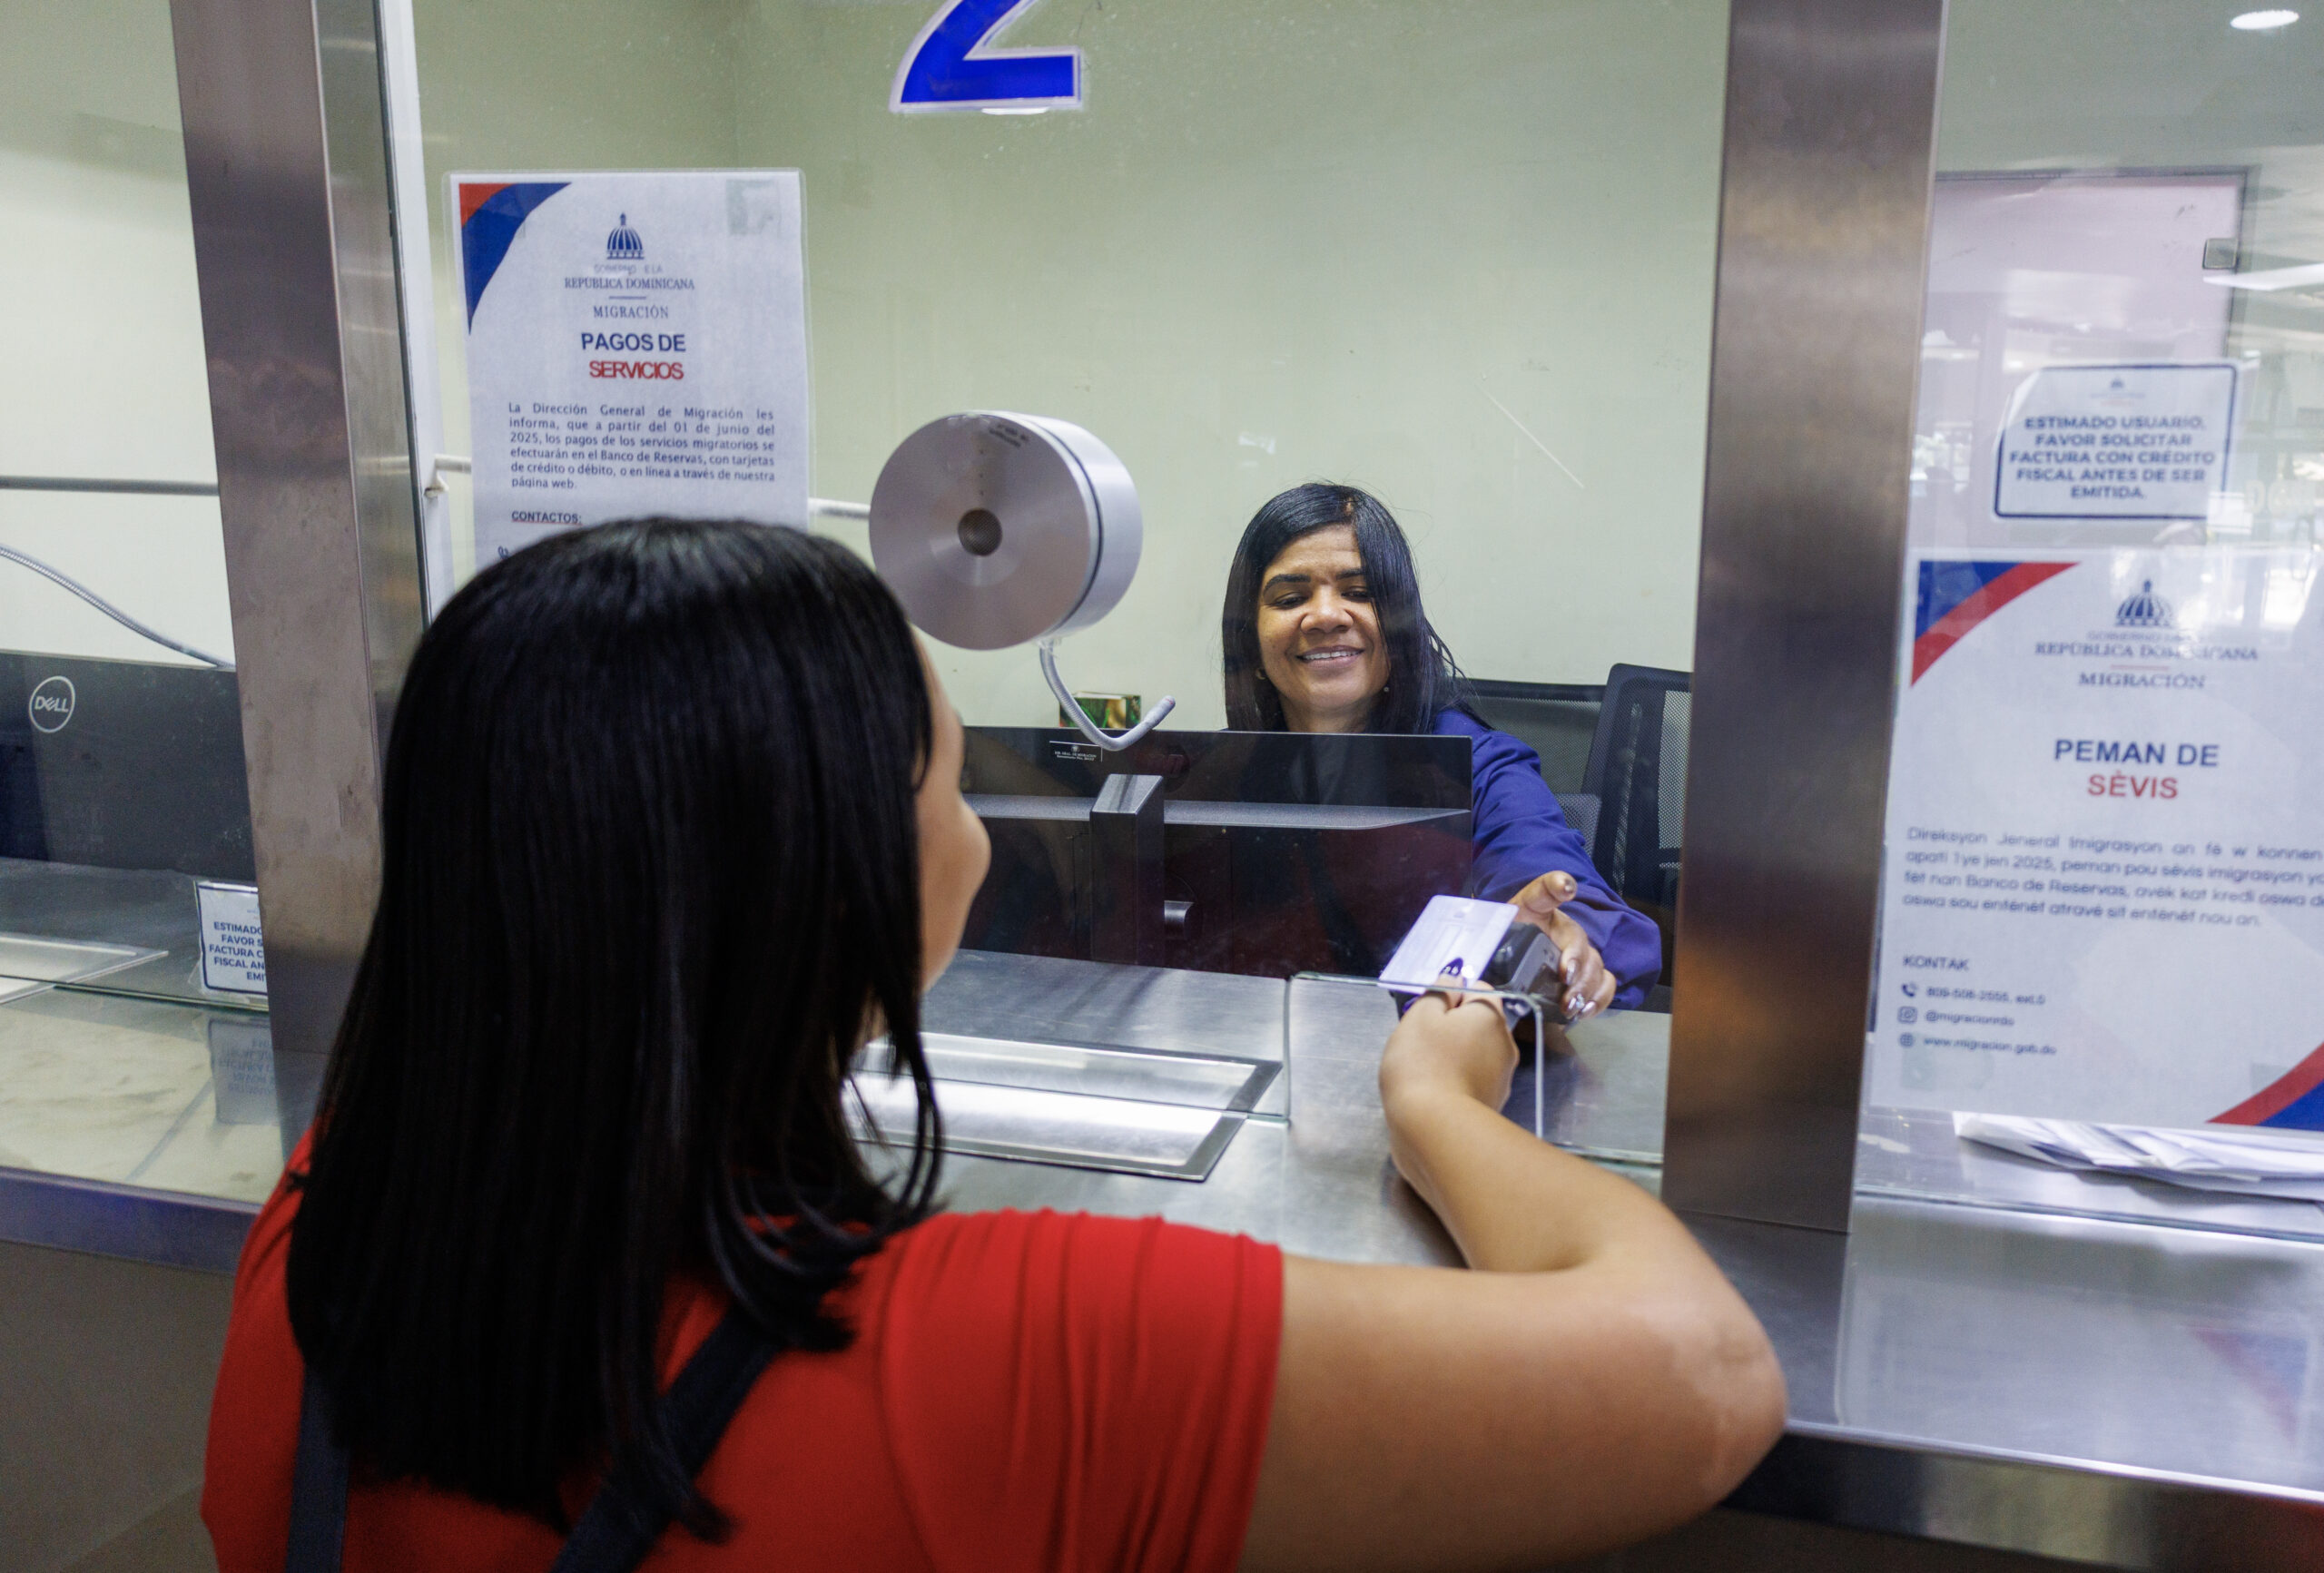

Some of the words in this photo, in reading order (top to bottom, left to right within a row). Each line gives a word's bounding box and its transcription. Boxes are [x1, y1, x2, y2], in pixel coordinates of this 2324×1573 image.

[565, 275, 623, 290] REPÚBLICA
[626, 278, 694, 290] DOMINICANA
[593, 304, 669, 319] MIGRACIÓN
[581, 332, 654, 352] PAGOS
[658, 333, 686, 352] DE
[589, 360, 684, 379] SERVICIOS
[508, 402, 521, 413] La
[533, 402, 587, 415] Dirección
[600, 404, 645, 417] General
[658, 406, 672, 418] de
[684, 407, 743, 420] Migración
[756, 408, 773, 419] les
[509, 418, 559, 430] informa,
[567, 420, 588, 431] que
[596, 422, 602, 430] a
[608, 420, 641, 433] partir
[648, 420, 666, 432] del
[674, 421, 687, 432] 01
[695, 422, 710, 434] de
[717, 423, 750, 436] junio
[757, 424, 774, 436] del
[2024, 416, 2117, 429] ESTIMADO
[510, 431, 542, 445] 2025,
[546, 433, 561, 444] los
[565, 435, 597, 447] pagos
[602, 435, 615, 446] de
[619, 436, 635, 447] los
[640, 437, 688, 448] servicios
[693, 439, 758, 451] migratorios
[763, 442, 774, 451] se
[2034, 434, 2095, 447] FAVOR
[2102, 433, 2193, 447] SOLICITAR
[510, 446, 568, 459] efectuarán
[572, 449, 585, 459] en
[588, 449, 597, 459] el
[601, 450, 634, 461] Banco
[637, 451, 650, 462] de
[654, 451, 707, 465] Reservas,
[709, 456, 730, 465] con
[732, 455, 774, 467] tarjetas
[2009, 451, 2091, 464] FACTURA
[2095, 451, 2133, 464] CON
[2137, 448, 2216, 465] CRÉDITO
[511, 461, 524, 472] de
[527, 462, 566, 474] crédito
[567, 466, 575, 474] o
[577, 464, 616, 477] débito,
[620, 467, 626, 477] o
[629, 467, 643, 477] en
[645, 466, 671, 477] línea
[674, 469, 680, 478] a
[683, 467, 714, 479] través
[718, 468, 731, 480] de
[734, 471, 774, 481] nuestra
[2016, 468, 2074, 481] FISCAL
[2080, 468, 2137, 481] ANTES
[2142, 468, 2165, 481] DE
[2171, 469, 2206, 481] SER
[511, 477, 548, 488] página
[2070, 486, 2146, 500] EMITIDA.
[511, 510, 582, 524] CONTACTOS:
[2034, 640, 2133, 658] REPÚBLICA
[2078, 671, 2207, 689] MIGRACIÓN
[34, 695, 69, 713] DELL
[2054, 739, 2166, 765] PEMAN
[2176, 742, 2221, 767] DE
[1908, 826, 1987, 845] Direksyon
[1999, 832, 2060, 849] Jeneral
[2171, 841, 2196, 855] an
[2232, 845, 2249, 857] w
[1905, 850, 1949, 864] apati
[1984, 853, 2010, 869] jen
[2013, 855, 2057, 872] 2025,
[2060, 860, 2122, 875] peman
[2124, 863, 2158, 878] pou
[2207, 866, 2304, 885] imigrasyon
[1929, 872, 1962, 887] nan
[1965, 873, 2020, 891] Banco
[2023, 878, 2045, 891] de
[2049, 878, 2130, 898] Reservas,
[2180, 887, 2208, 901] kat
[2211, 889, 2256, 904] kredi
[2258, 891, 2307, 907] aswa
[1902, 894, 1946, 908] aswa
[1948, 895, 1979, 909] sou
[2107, 905, 2126, 919] sit
[2199, 911, 2233, 926] nou
[222, 934, 255, 946] FAVOR
[209, 944, 254, 959] FACTURA
[213, 957, 248, 969] FISCAL
[1903, 955, 1970, 971] KONTAK
